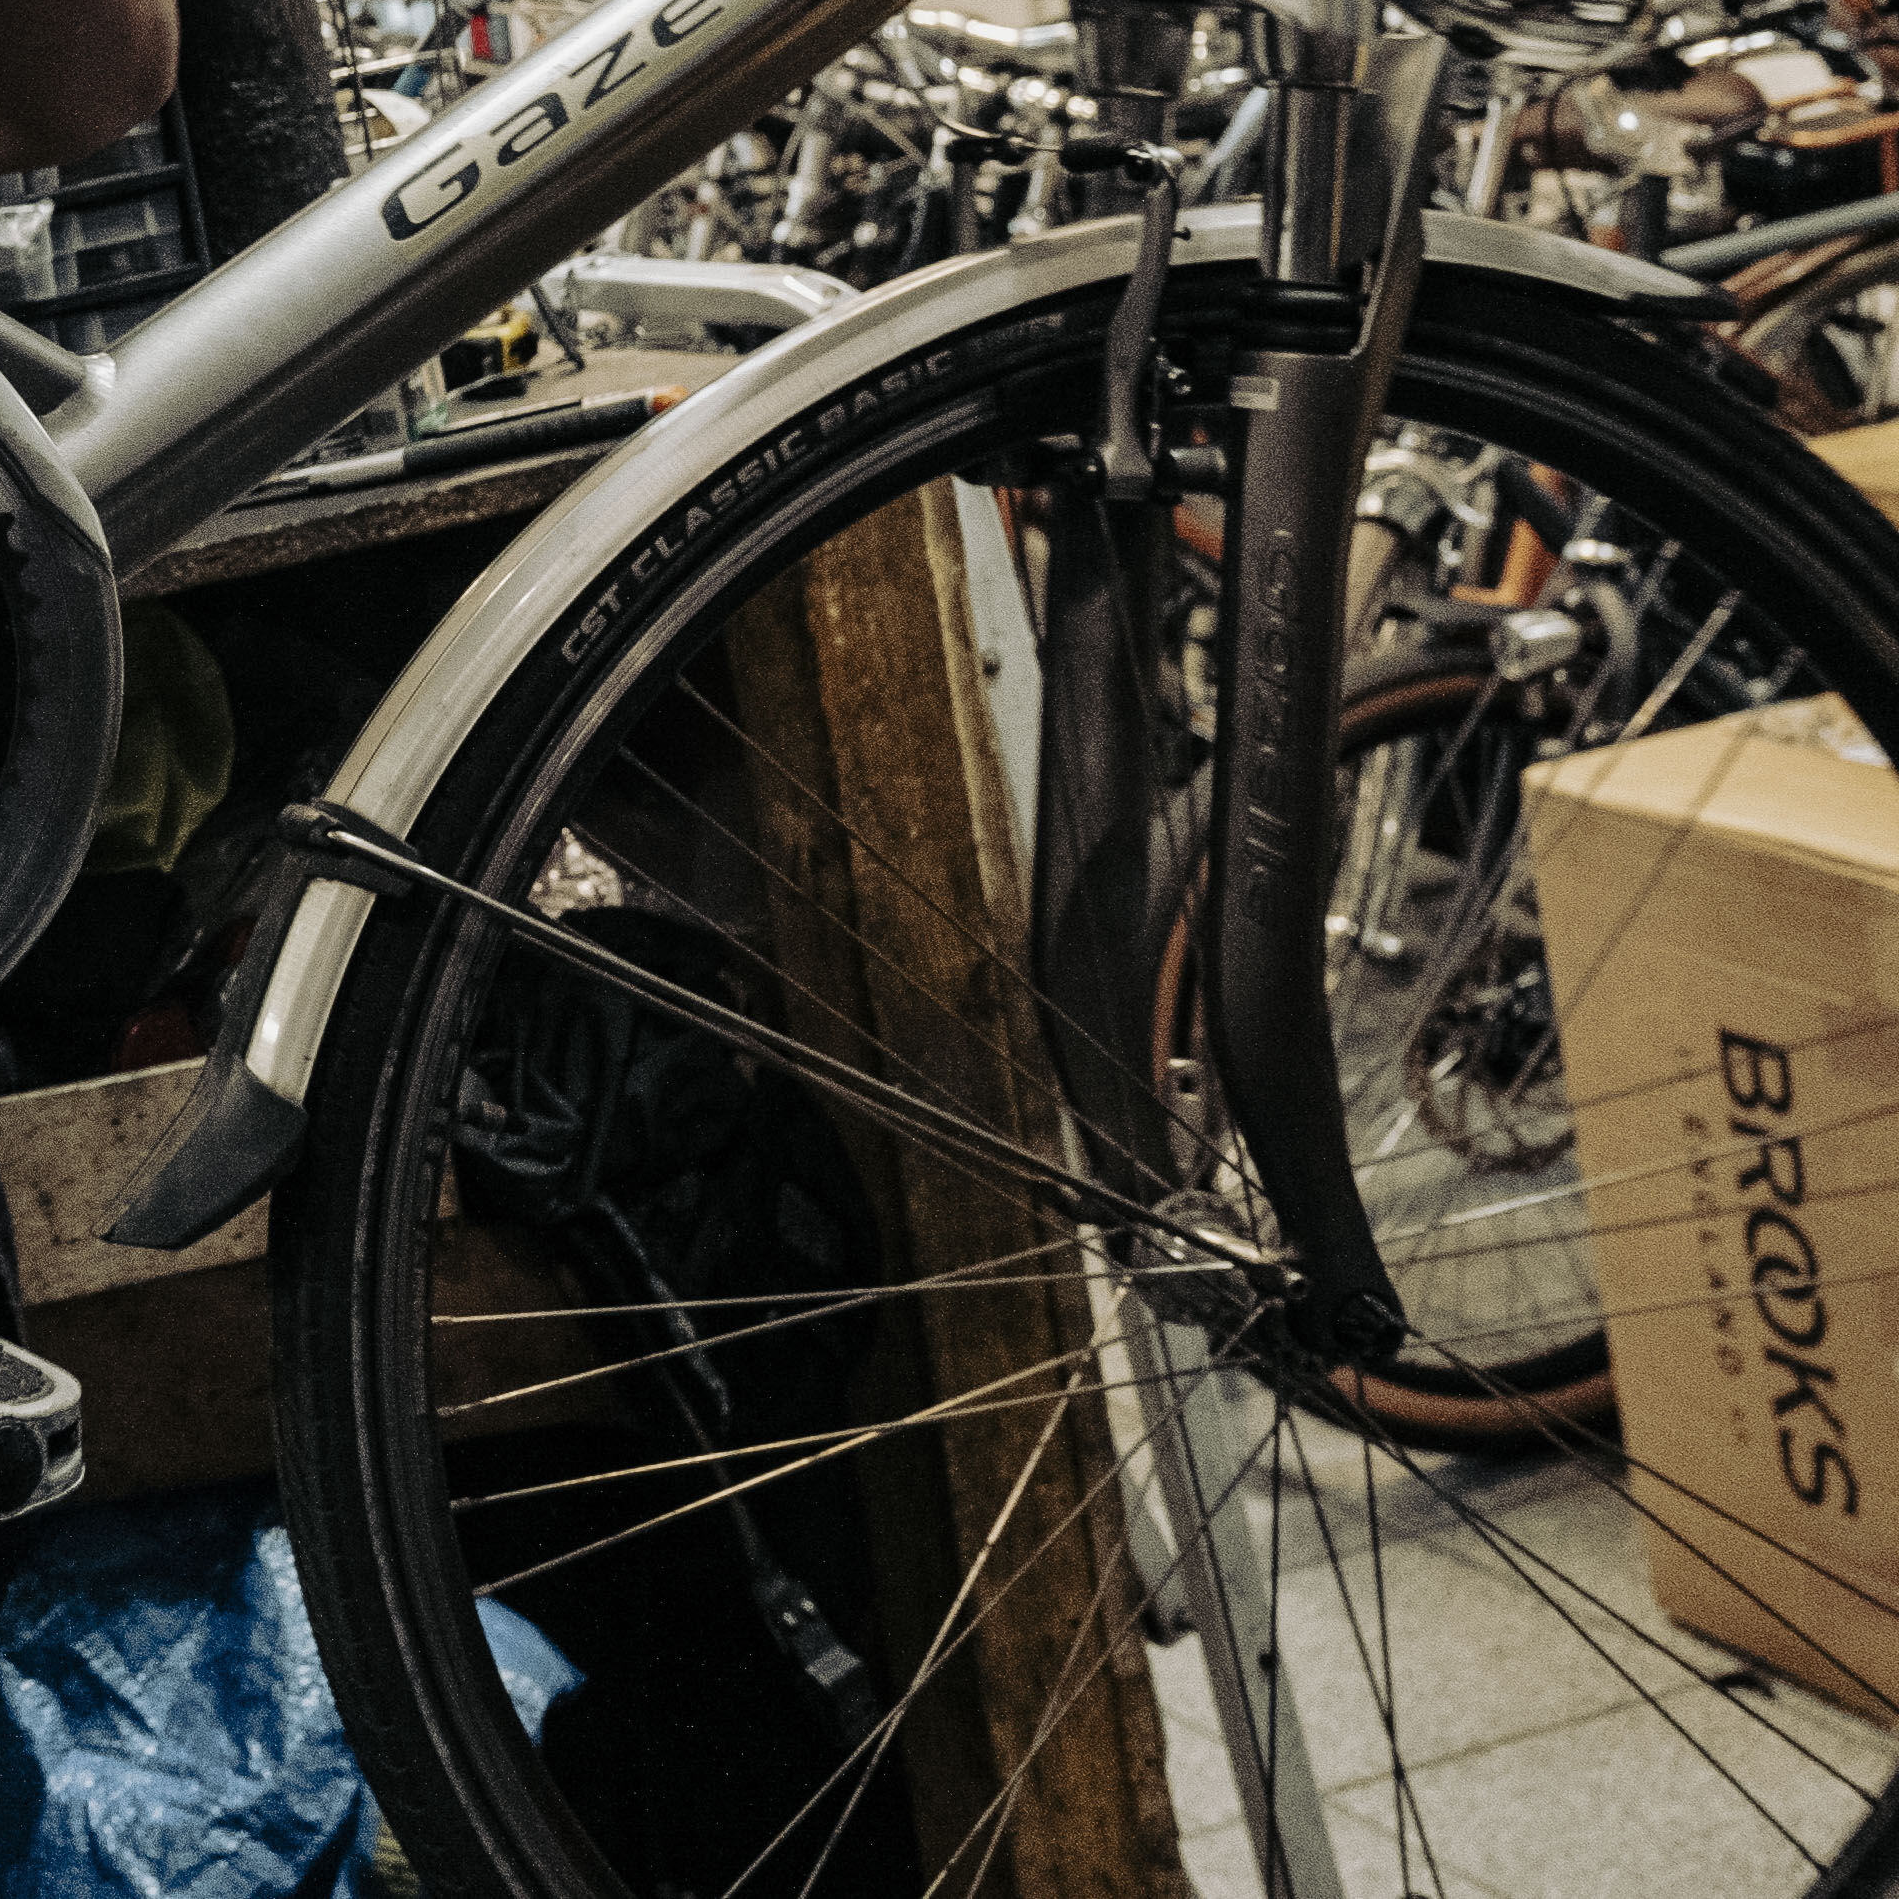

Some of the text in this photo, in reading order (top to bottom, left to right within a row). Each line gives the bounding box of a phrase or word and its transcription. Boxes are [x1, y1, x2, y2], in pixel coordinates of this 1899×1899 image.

[560, 349, 954, 666] CST CLASSIC BASIC
[1720, 1028, 1859, 1518] BROOKS
